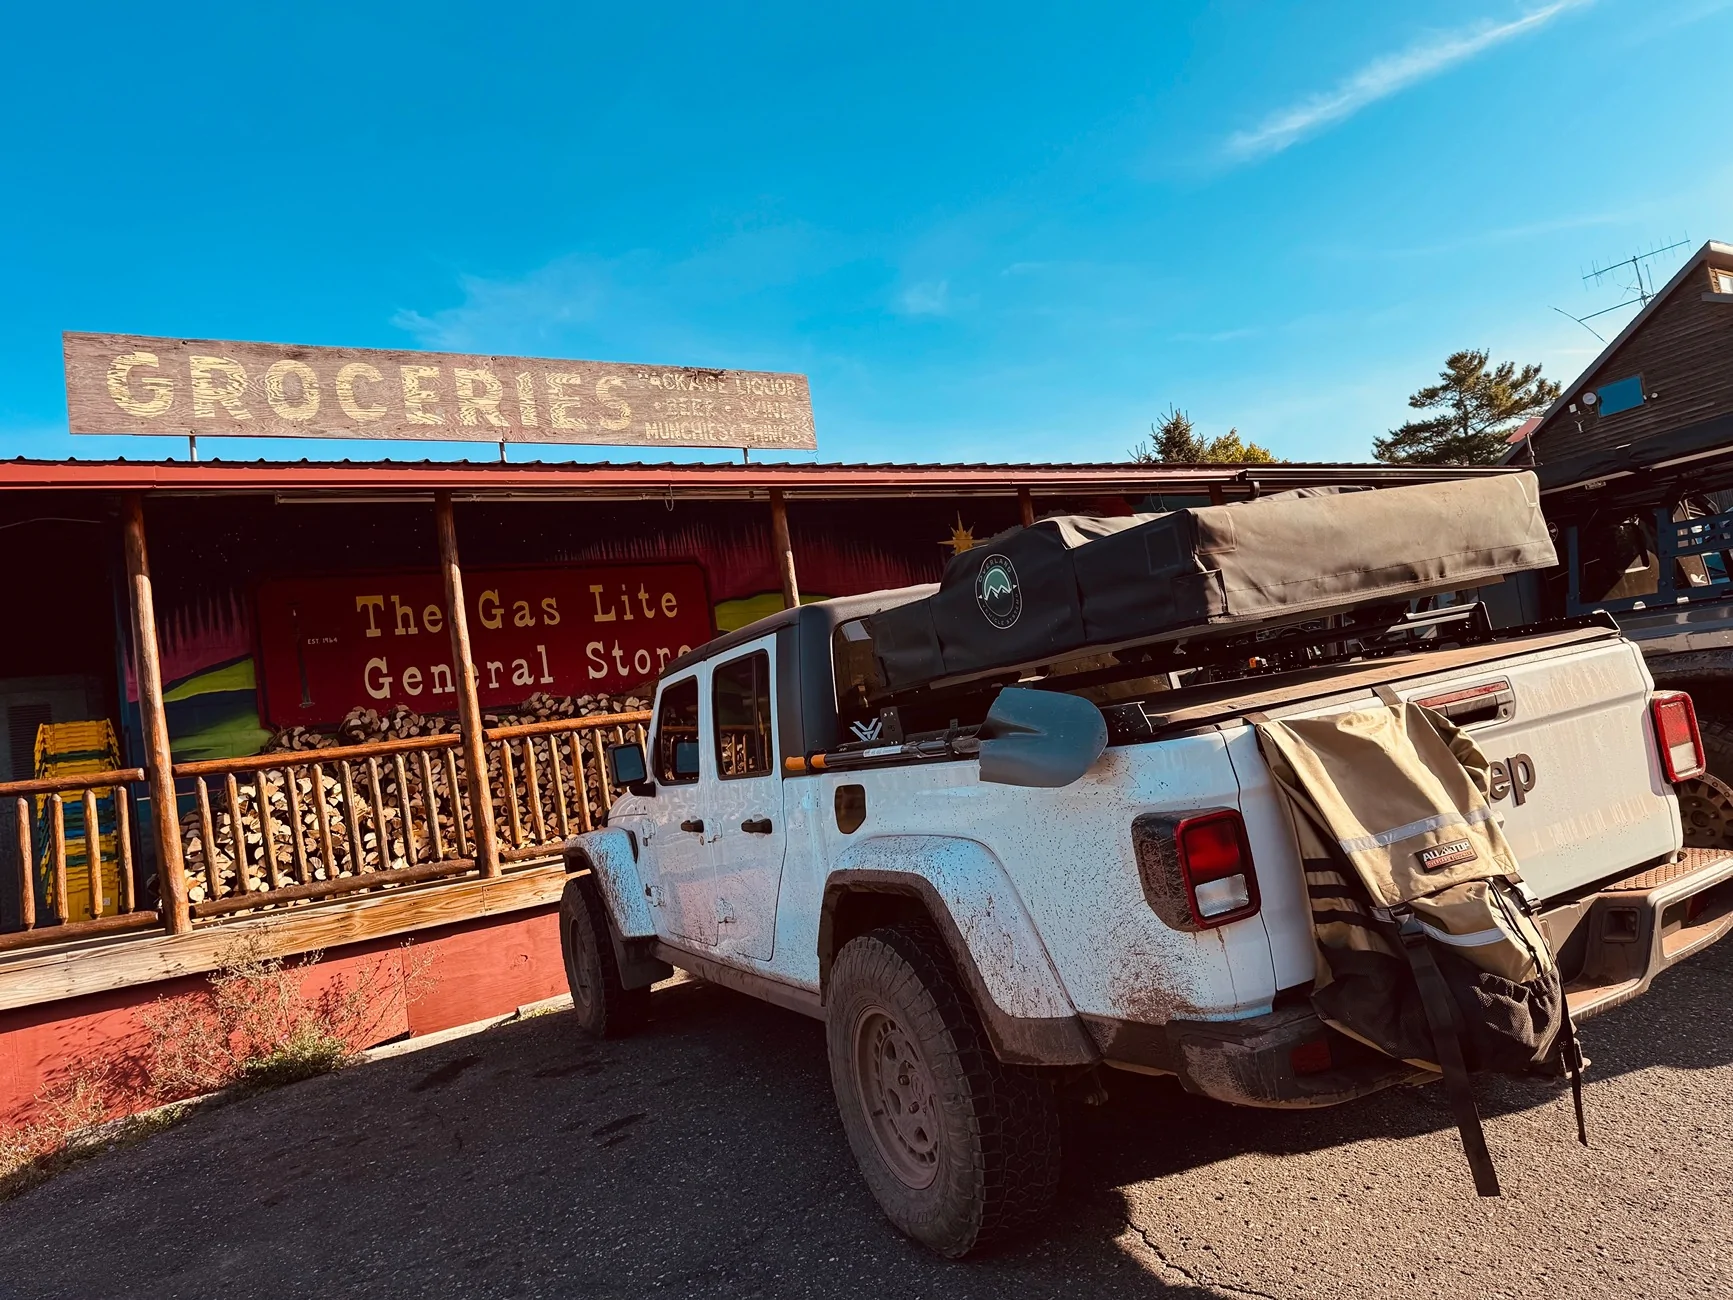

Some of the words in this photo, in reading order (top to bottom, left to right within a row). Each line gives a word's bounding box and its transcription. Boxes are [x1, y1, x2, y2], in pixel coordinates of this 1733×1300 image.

[107, 350, 631, 431] GROCERIES
[736, 377, 798, 397] LIQUOR
[645, 421, 729, 441] MUNCHIES
[979, 558, 1012, 583] OVERLAND
[356, 595, 443, 637] The
[479, 589, 561, 629] Gas
[590, 583, 678, 622] Lite
[1490, 753, 1537, 808] ep
